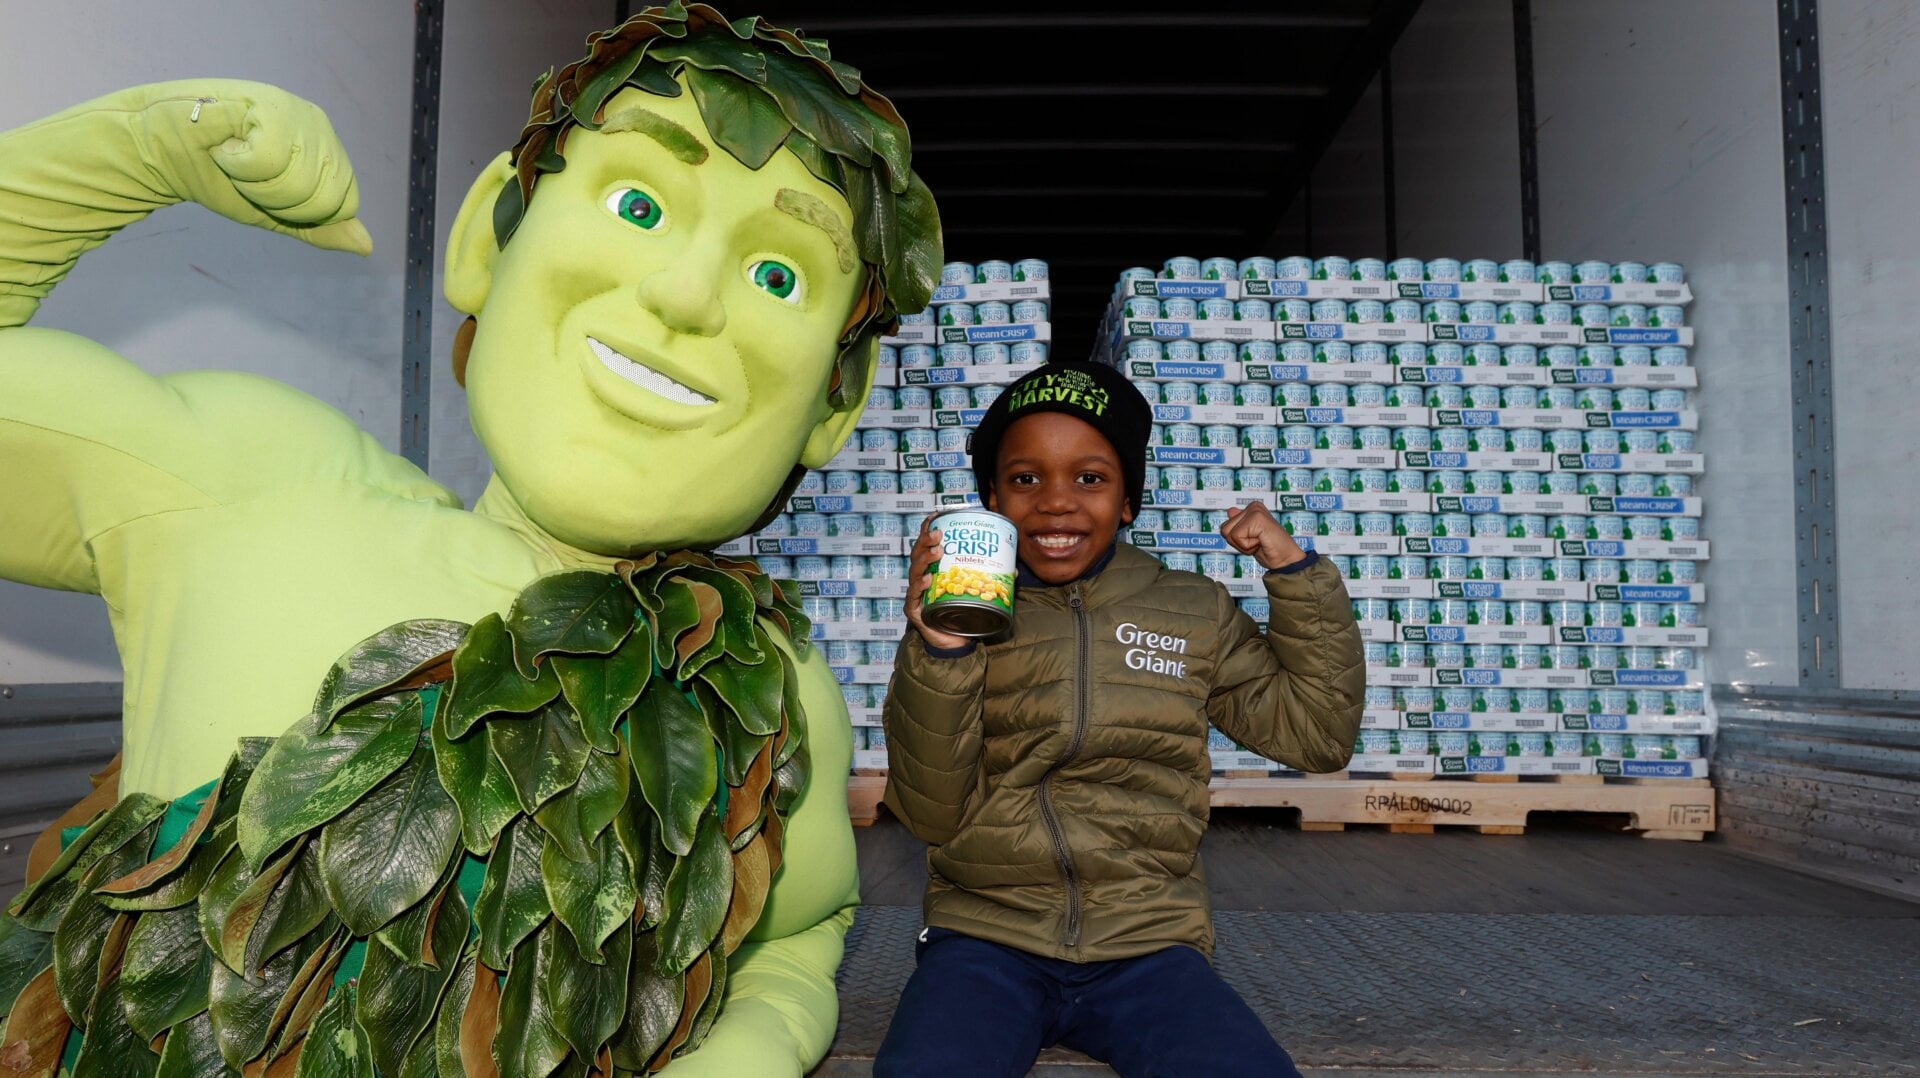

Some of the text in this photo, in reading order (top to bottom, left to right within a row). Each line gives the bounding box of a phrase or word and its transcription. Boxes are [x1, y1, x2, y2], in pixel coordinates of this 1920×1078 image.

[1162, 286, 1218, 294] steam CRISP
[972, 329, 1028, 339] steam CRISP
[1160, 366, 1217, 375] steam CRISP
[1009, 387, 1107, 417] HARVEST
[1160, 451, 1217, 460] steam CRISP
[944, 528, 999, 545] steam
[1162, 537, 1218, 545] steam CRISP
[944, 541, 999, 557] CRISP
[955, 556, 984, 564] Niblets
[1116, 623, 1187, 654] Green
[1125, 648, 1187, 678] Giant
[1365, 793, 1472, 816] RPAL000002
